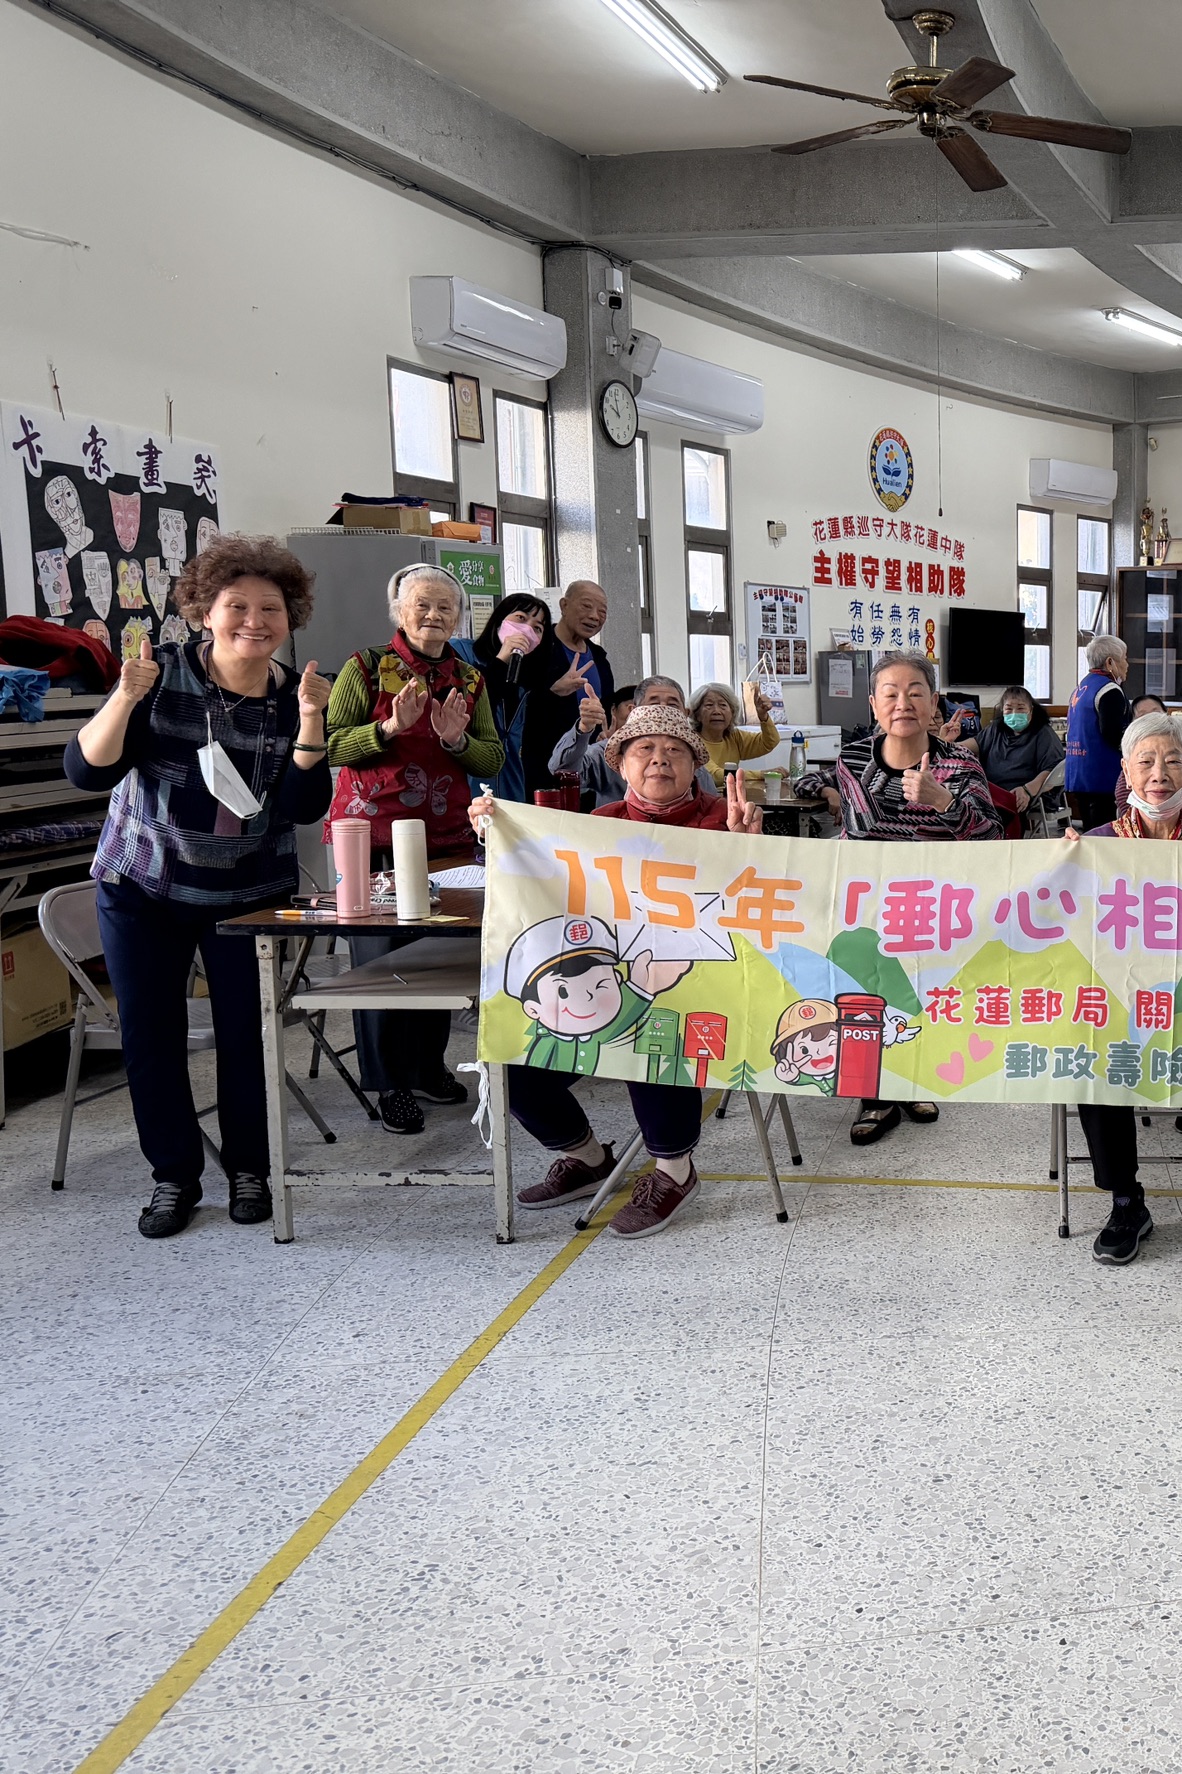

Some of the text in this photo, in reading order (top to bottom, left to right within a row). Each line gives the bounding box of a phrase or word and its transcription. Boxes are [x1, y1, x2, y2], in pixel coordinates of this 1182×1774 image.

[882, 477, 902, 488] Hualien
[812, 515, 965, 561] 花蓮縣巡守大隊花蓮中隊
[813, 549, 966, 597] 主權守望相助隊
[554, 849, 805, 949] 115年
[568, 924, 589, 942] 郵
[925, 985, 1109, 1028] 花蓮郵局
[842, 1028, 878, 1041] POST
